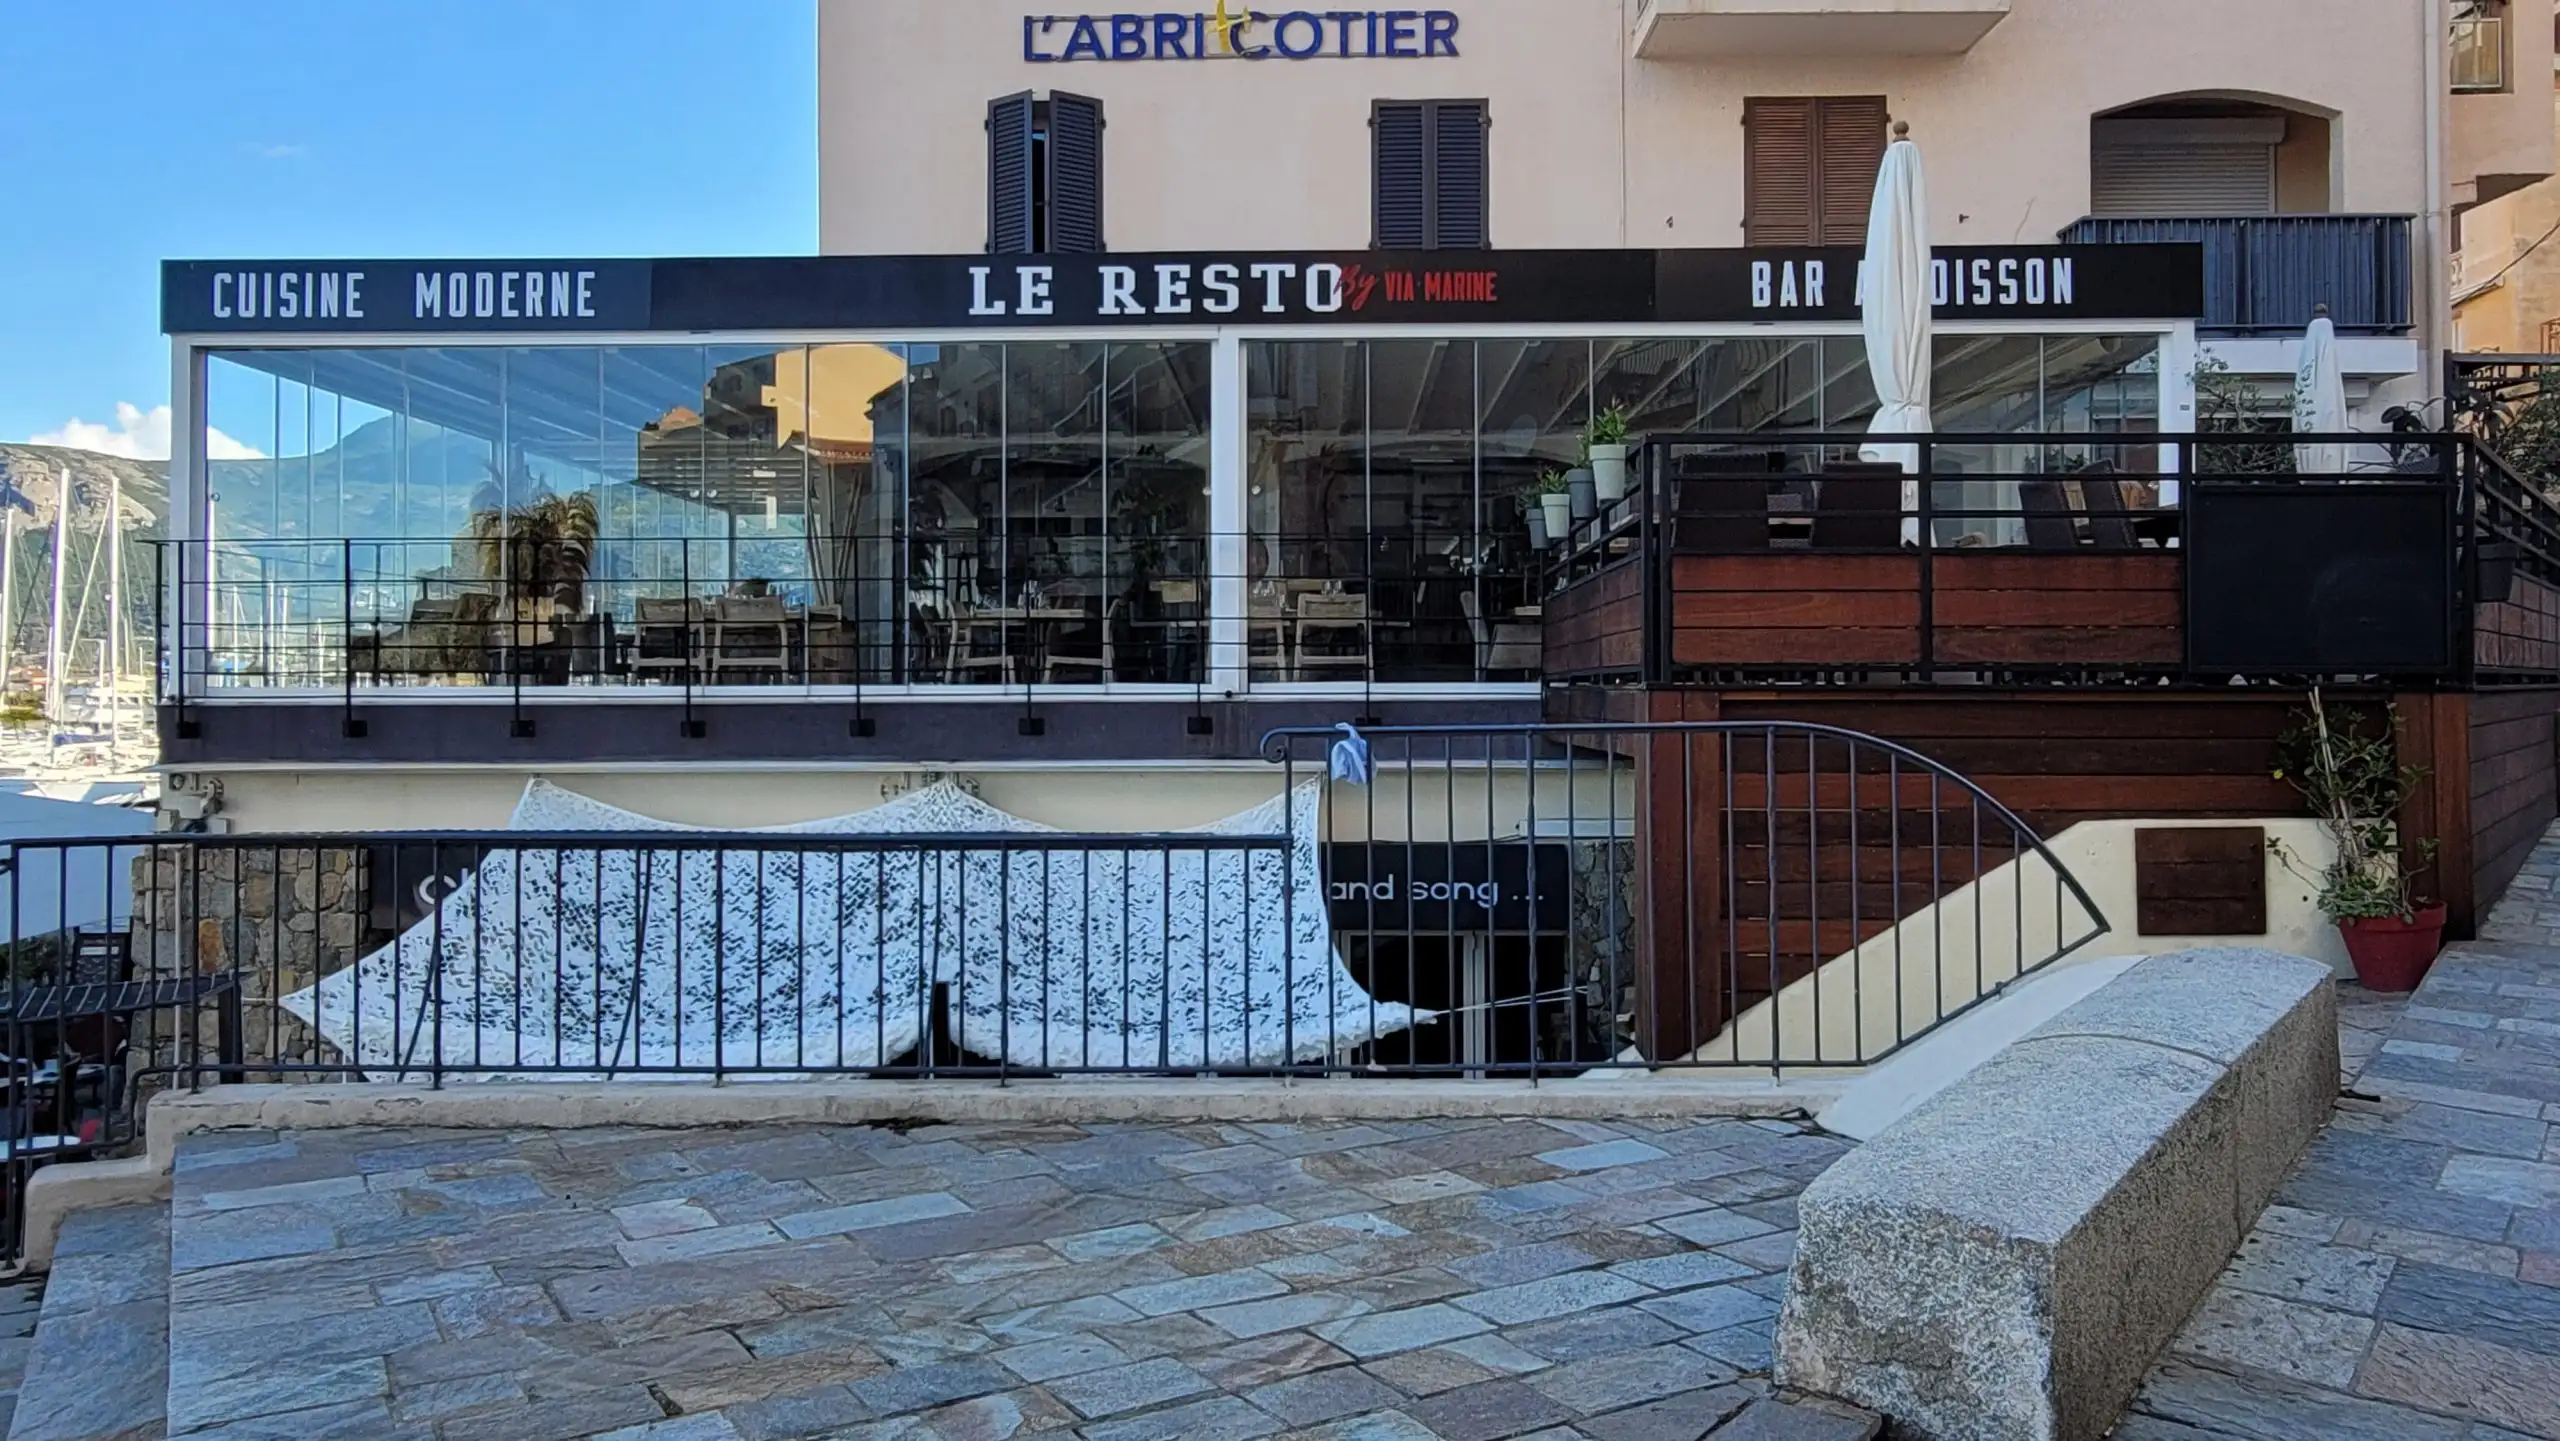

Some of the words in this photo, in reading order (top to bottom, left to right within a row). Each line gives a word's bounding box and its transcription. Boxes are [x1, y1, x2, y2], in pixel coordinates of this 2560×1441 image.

[213, 272, 364, 318] CUISINE
[415, 271, 596, 317] MODERNE
[968, 265, 1054, 316] LE
[1098, 263, 1342, 315] RESTO
[1334, 264, 1380, 311] By
[1384, 271, 1415, 302] VIA
[1424, 271, 1498, 302] MARINE
[1751, 260, 1824, 308] BAR
[1930, 257, 2072, 306] OISSON
[1328, 873, 1394, 901] and
[1408, 880, 1498, 909] song
